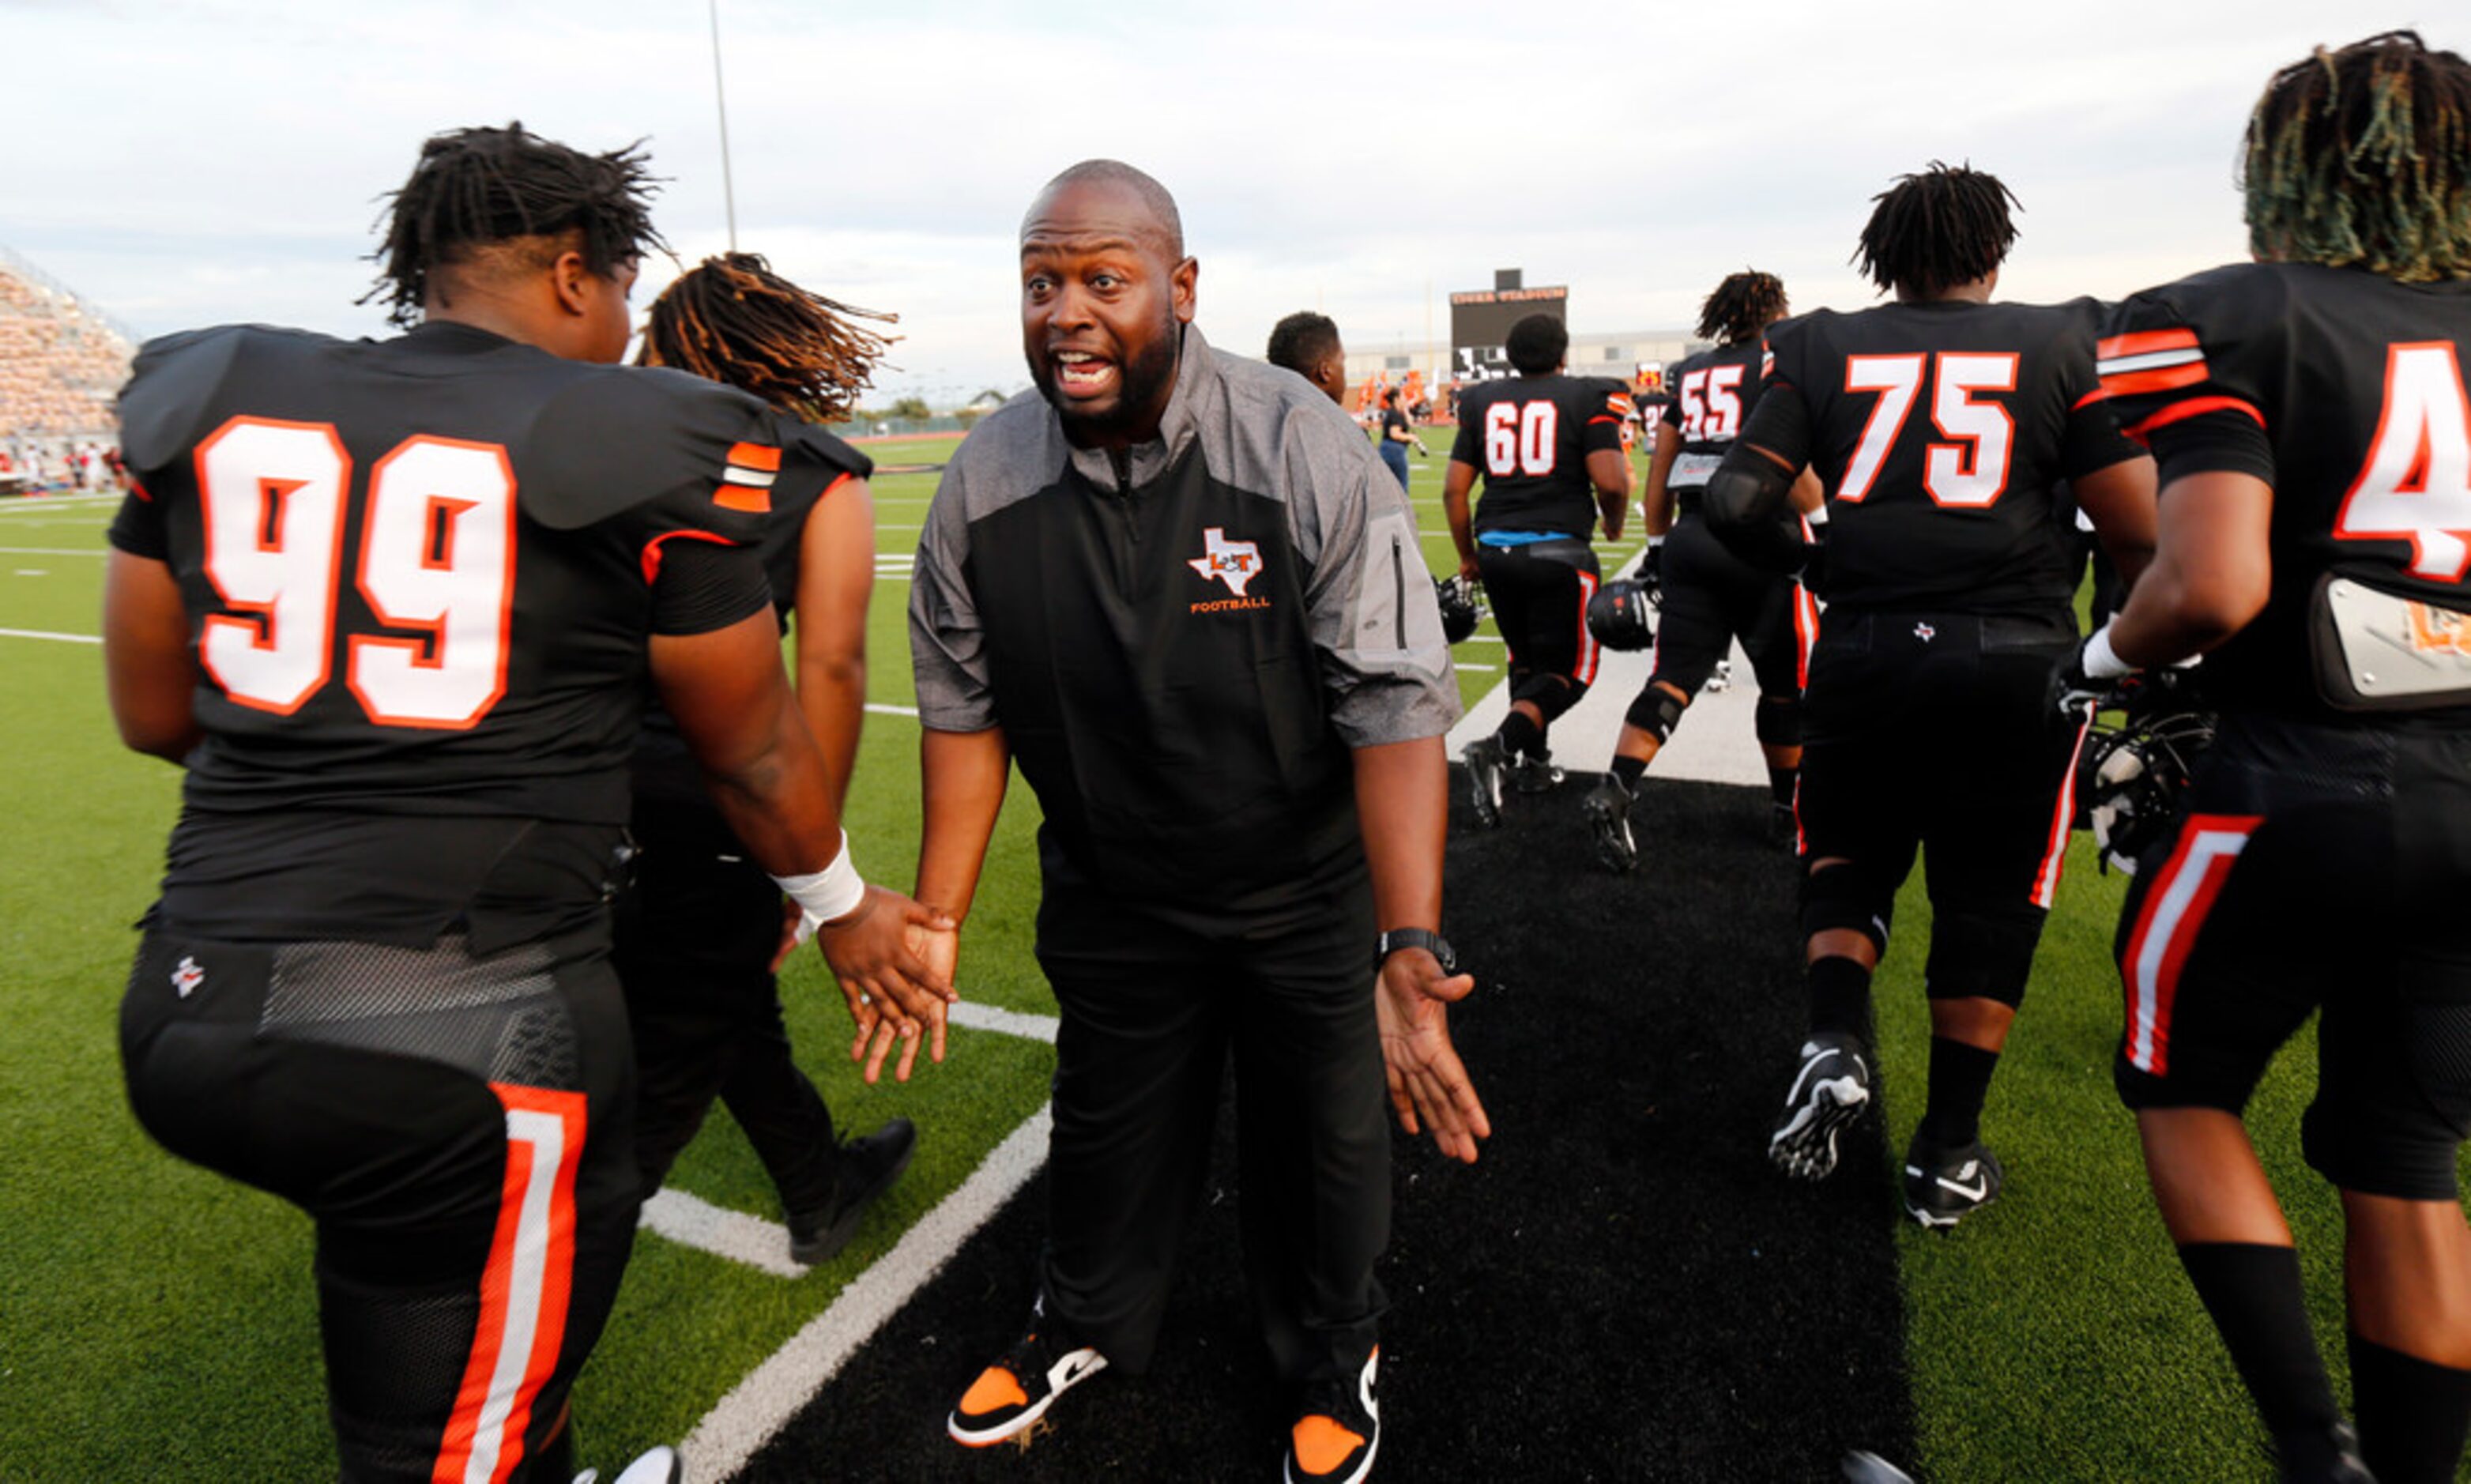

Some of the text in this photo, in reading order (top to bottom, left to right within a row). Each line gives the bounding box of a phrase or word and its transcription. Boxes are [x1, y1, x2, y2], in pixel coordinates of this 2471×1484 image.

[1486, 400, 1558, 476] 60
[1679, 363, 1746, 442] 55
[1835, 352, 2021, 508] 75
[193, 415, 518, 730] 99
[1190, 597, 1271, 614] FOOTBALL
